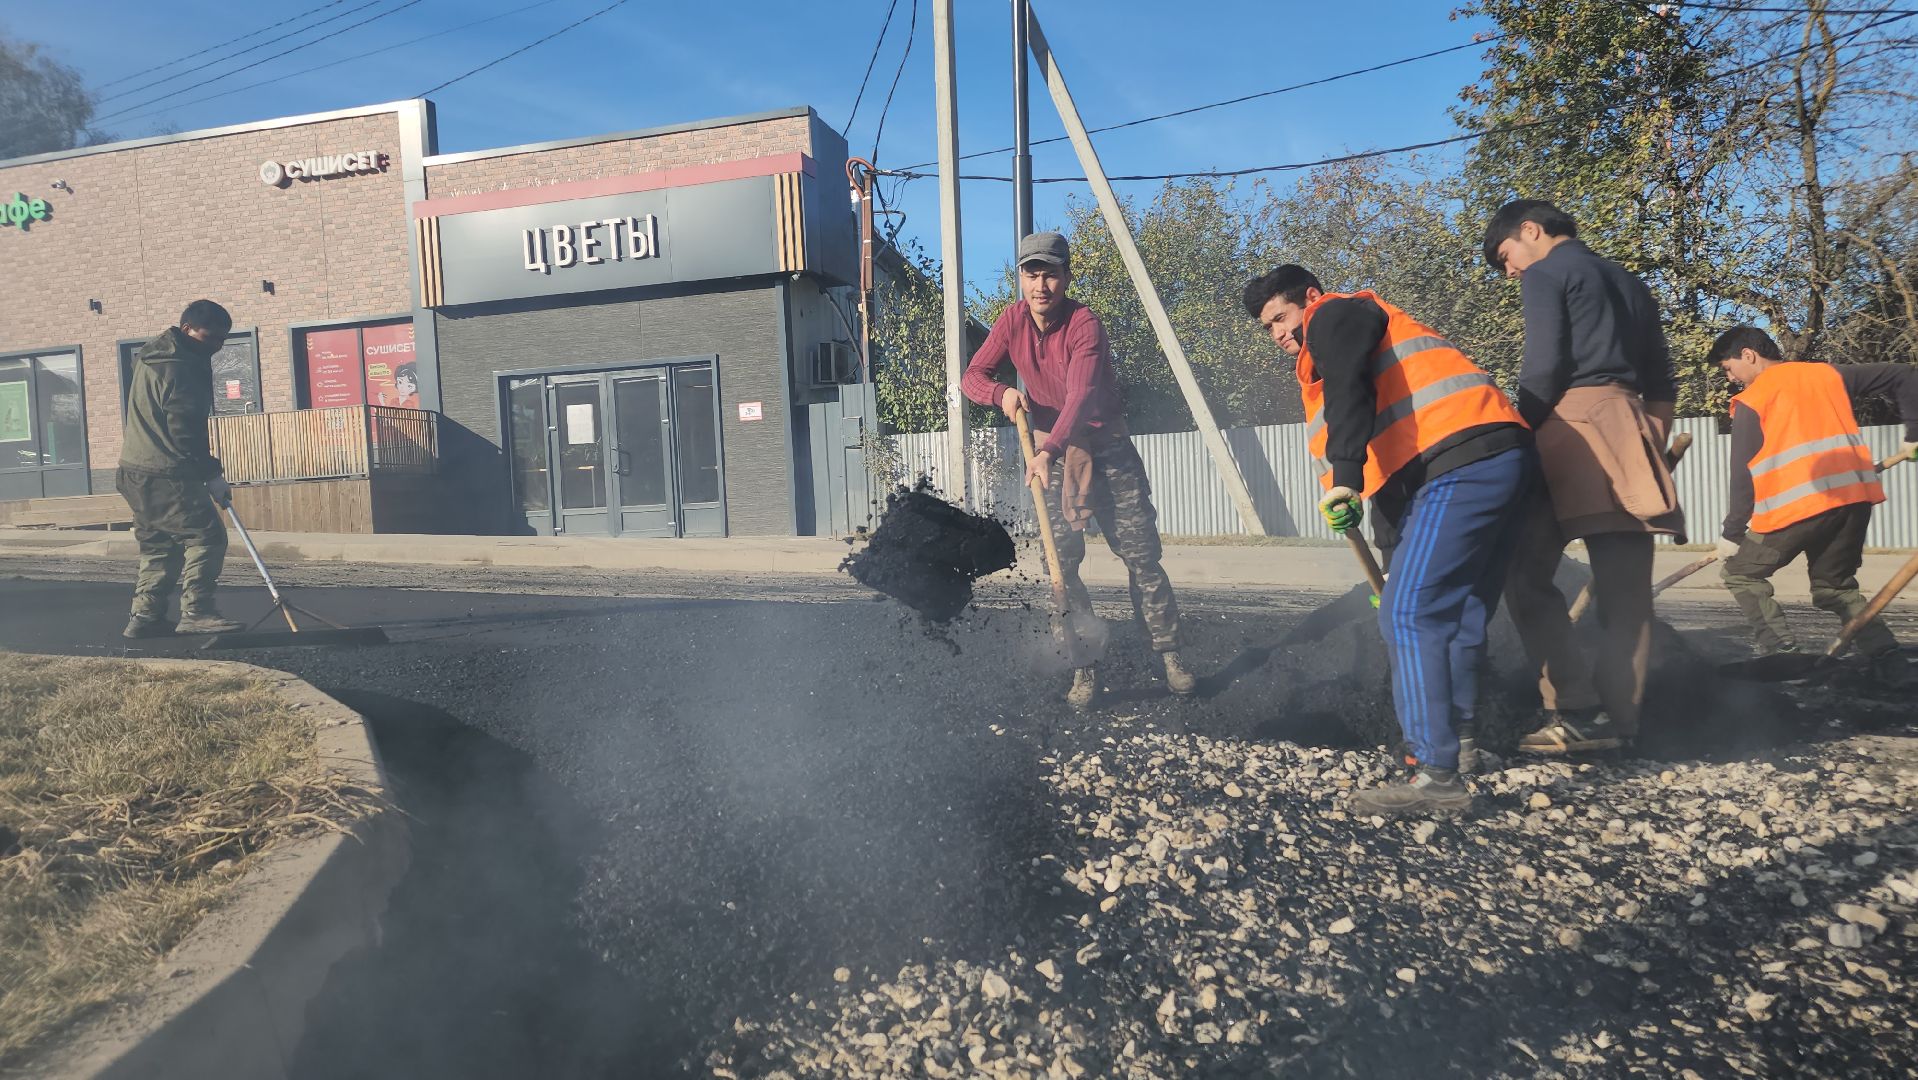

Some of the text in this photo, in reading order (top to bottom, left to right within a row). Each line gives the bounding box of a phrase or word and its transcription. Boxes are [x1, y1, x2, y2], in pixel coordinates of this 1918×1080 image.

[285, 150, 379, 178] СУШИСЕТ
[522, 213, 656, 273] ЦВЕТЫ
[366, 342, 416, 355] СУШИСЕТ
